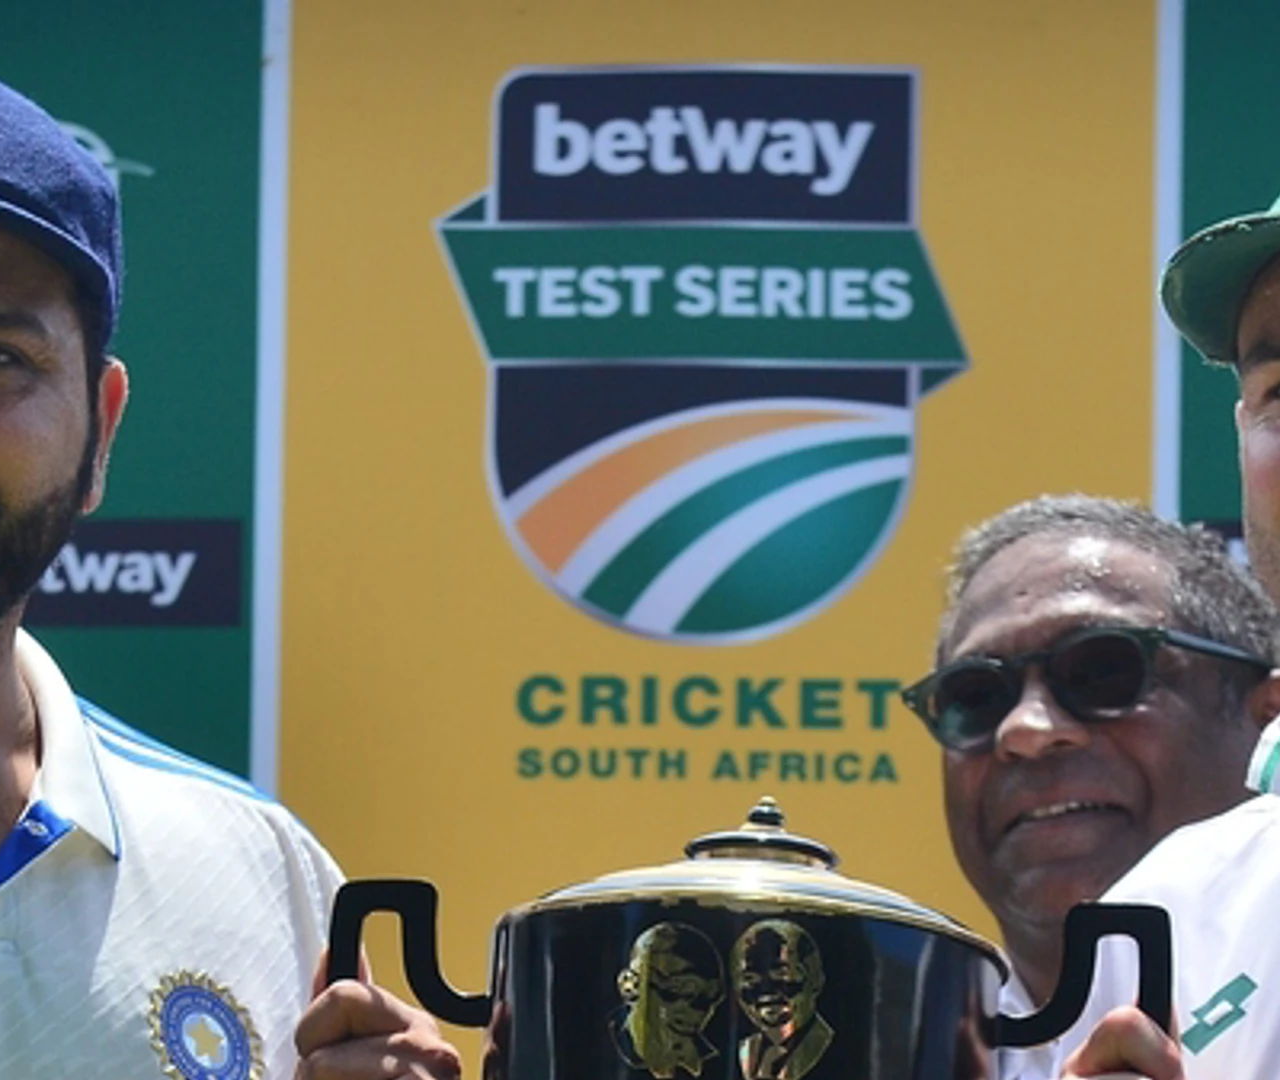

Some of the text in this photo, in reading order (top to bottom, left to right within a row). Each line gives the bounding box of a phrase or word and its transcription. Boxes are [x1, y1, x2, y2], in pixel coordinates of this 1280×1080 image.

[533, 103, 874, 195] betway
[493, 266, 913, 320] TEST SERIES
[39, 542, 197, 606] tway
[516, 674, 902, 729] CRICKET
[517, 748, 898, 783] SOUTH AFRICA
